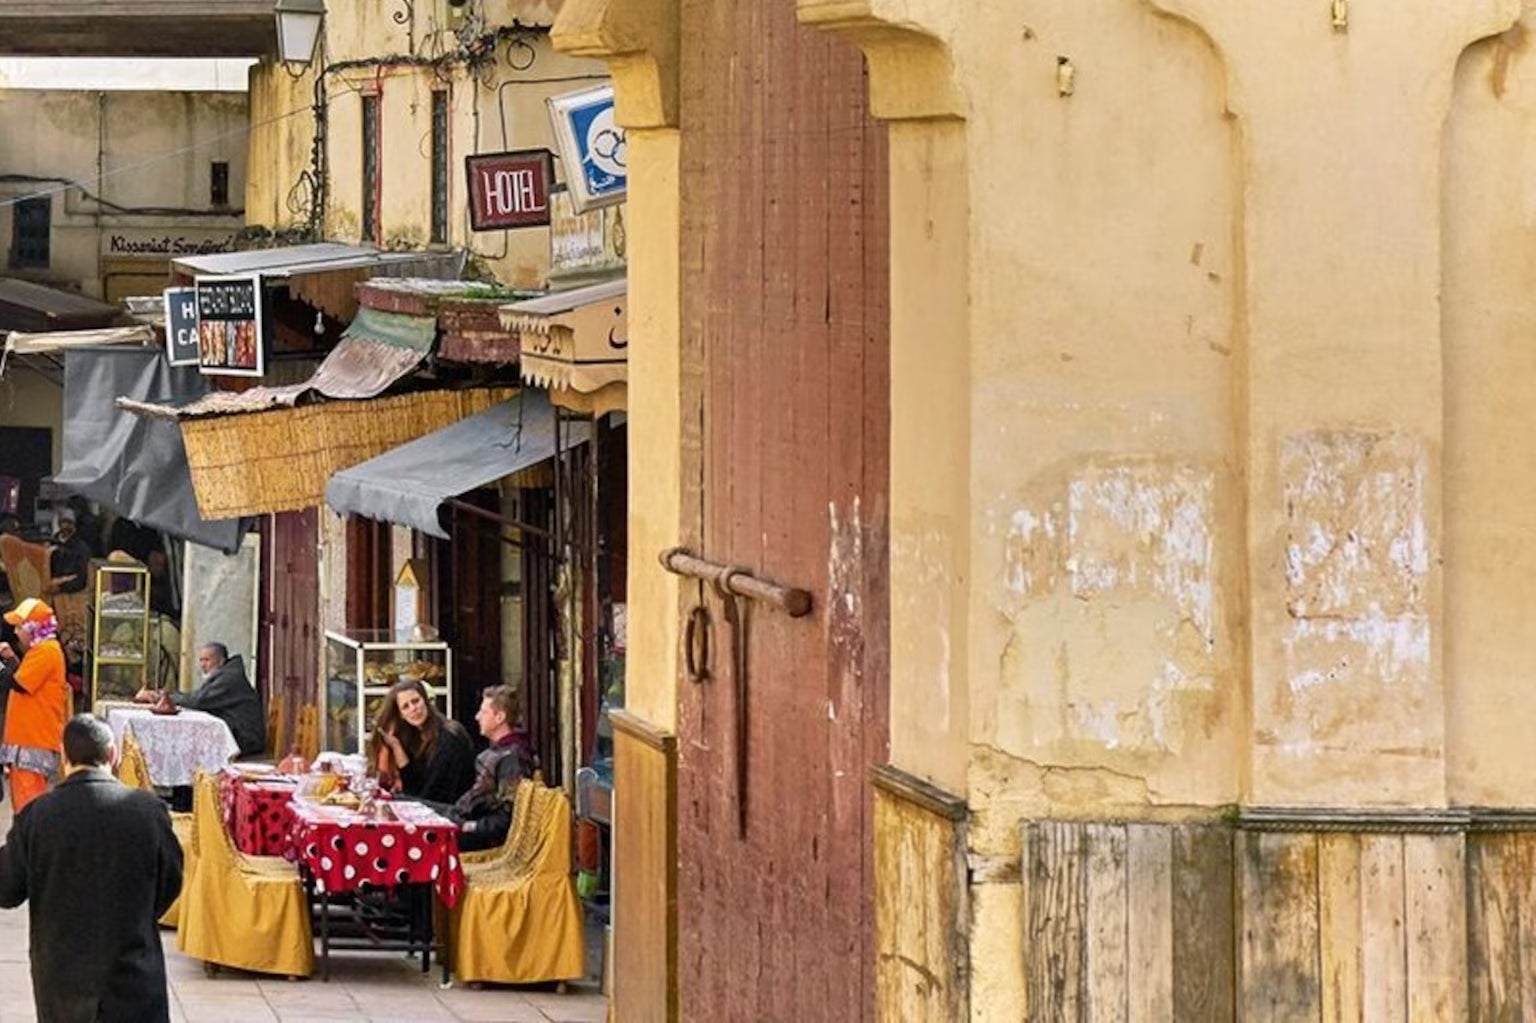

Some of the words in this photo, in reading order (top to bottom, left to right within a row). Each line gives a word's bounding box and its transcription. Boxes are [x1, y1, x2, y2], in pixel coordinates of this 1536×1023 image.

[482, 168, 547, 216] HOTEL
[181, 302, 195, 319] H
[177, 328, 199, 346] CA
